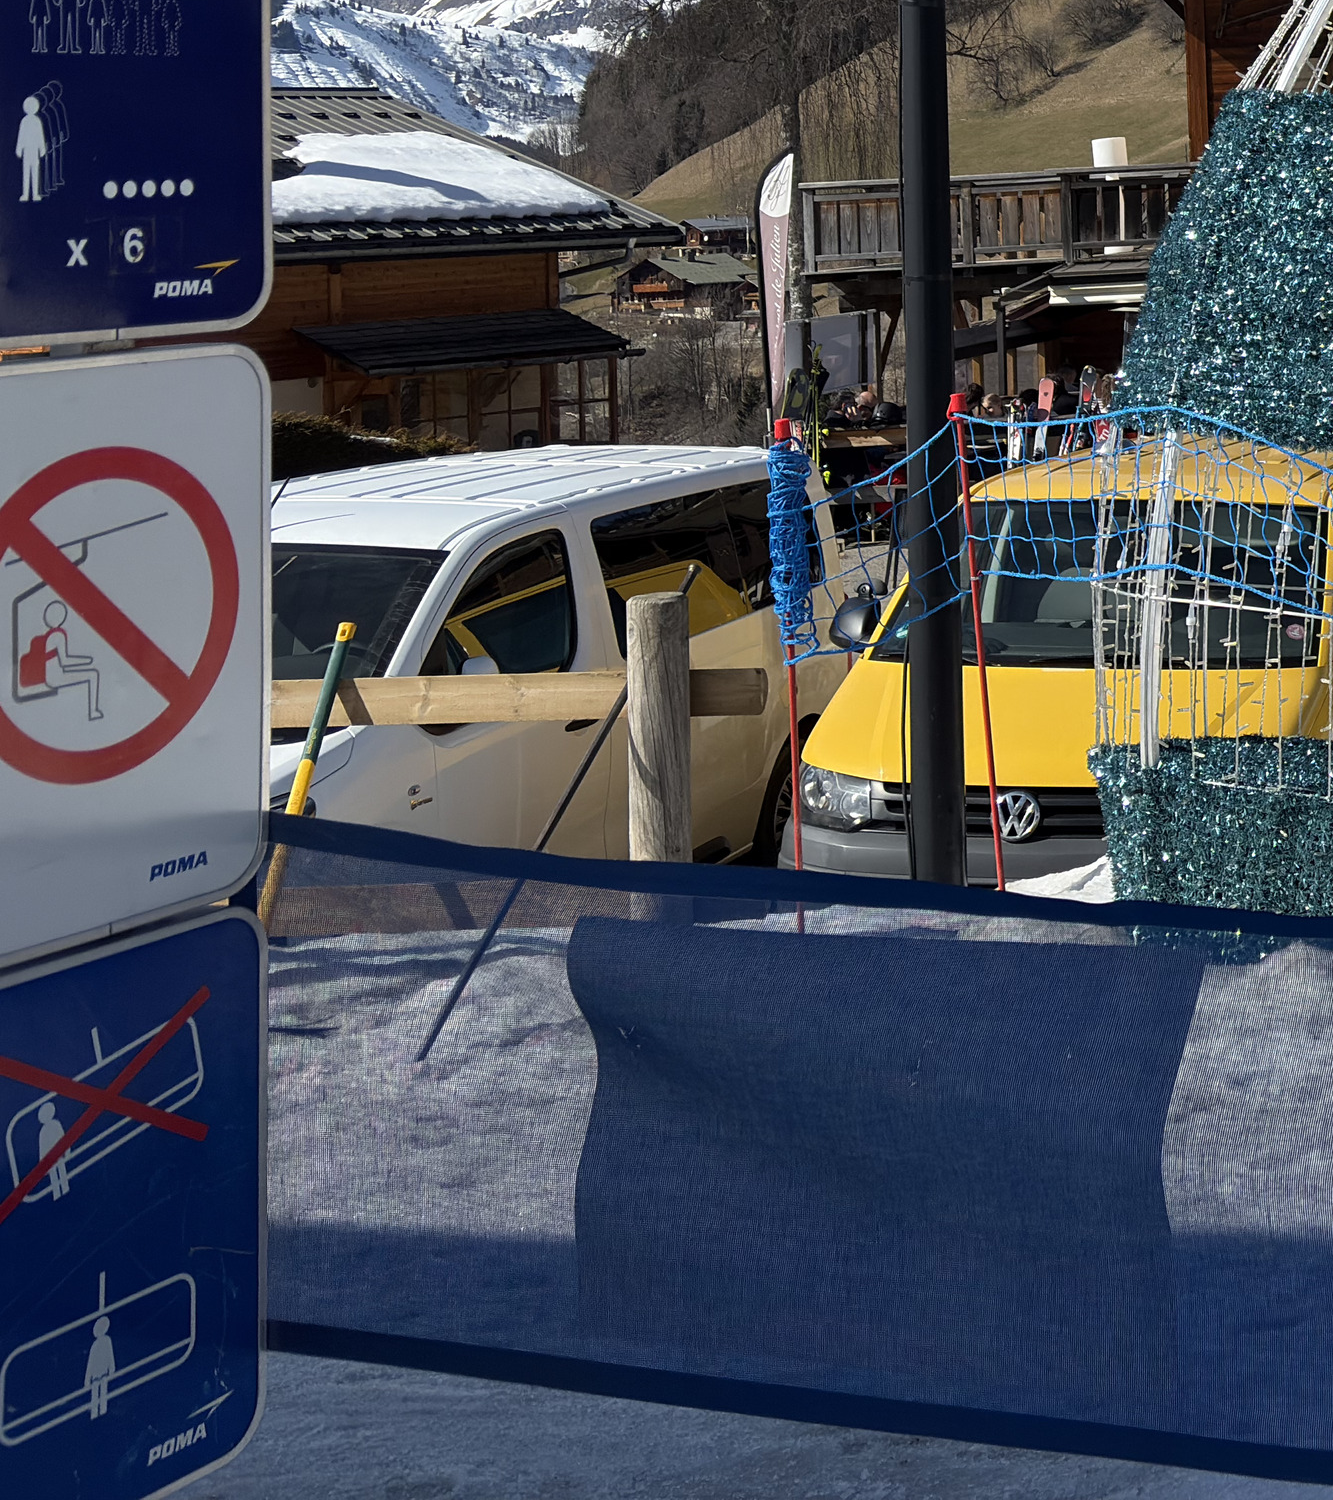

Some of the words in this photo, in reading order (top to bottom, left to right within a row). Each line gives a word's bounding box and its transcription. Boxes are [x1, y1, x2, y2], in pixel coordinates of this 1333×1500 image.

[122, 227, 145, 264] 6
[769, 222, 785, 279] Julien
[153, 278, 213, 299] POMA
[770, 278, 783, 299] de
[149, 850, 208, 882] POMA
[146, 1421, 207, 1467] POMA
